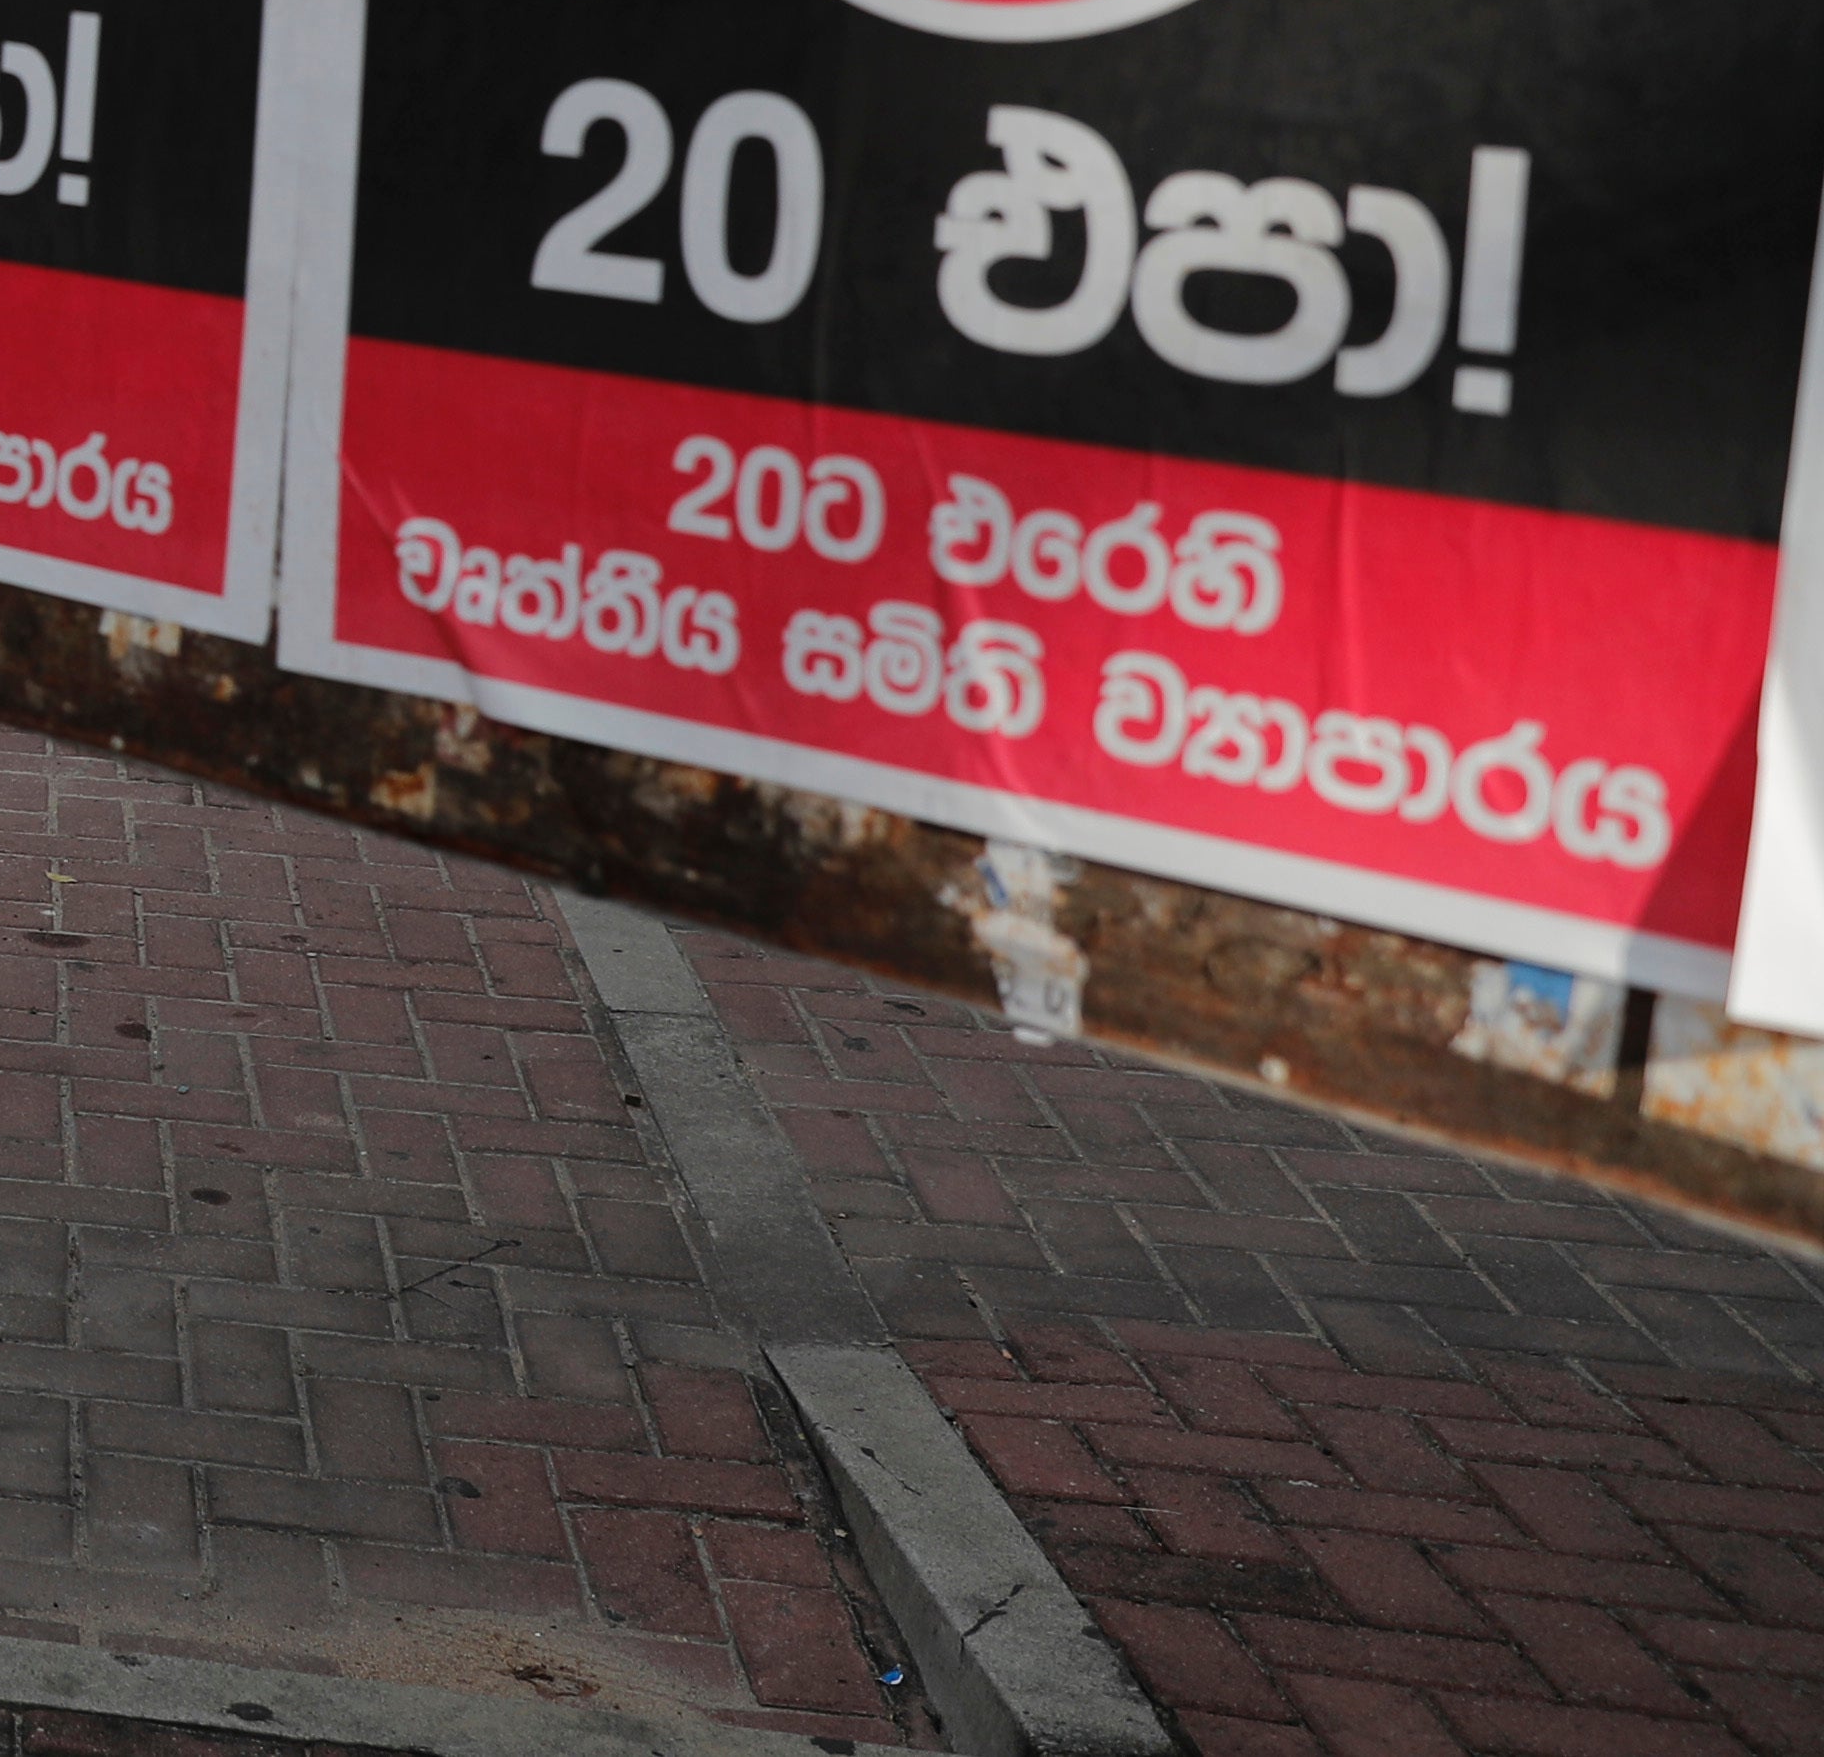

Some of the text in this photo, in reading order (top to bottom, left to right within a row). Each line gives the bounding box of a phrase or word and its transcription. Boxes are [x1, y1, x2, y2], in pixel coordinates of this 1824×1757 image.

[530, 76, 1532, 416] 20 එපා!
[394, 515, 743, 677] වෘත්තීය
[782, 602, 1047, 739] සමිති
[667, 435, 1288, 635] 20ට එරෙහි
